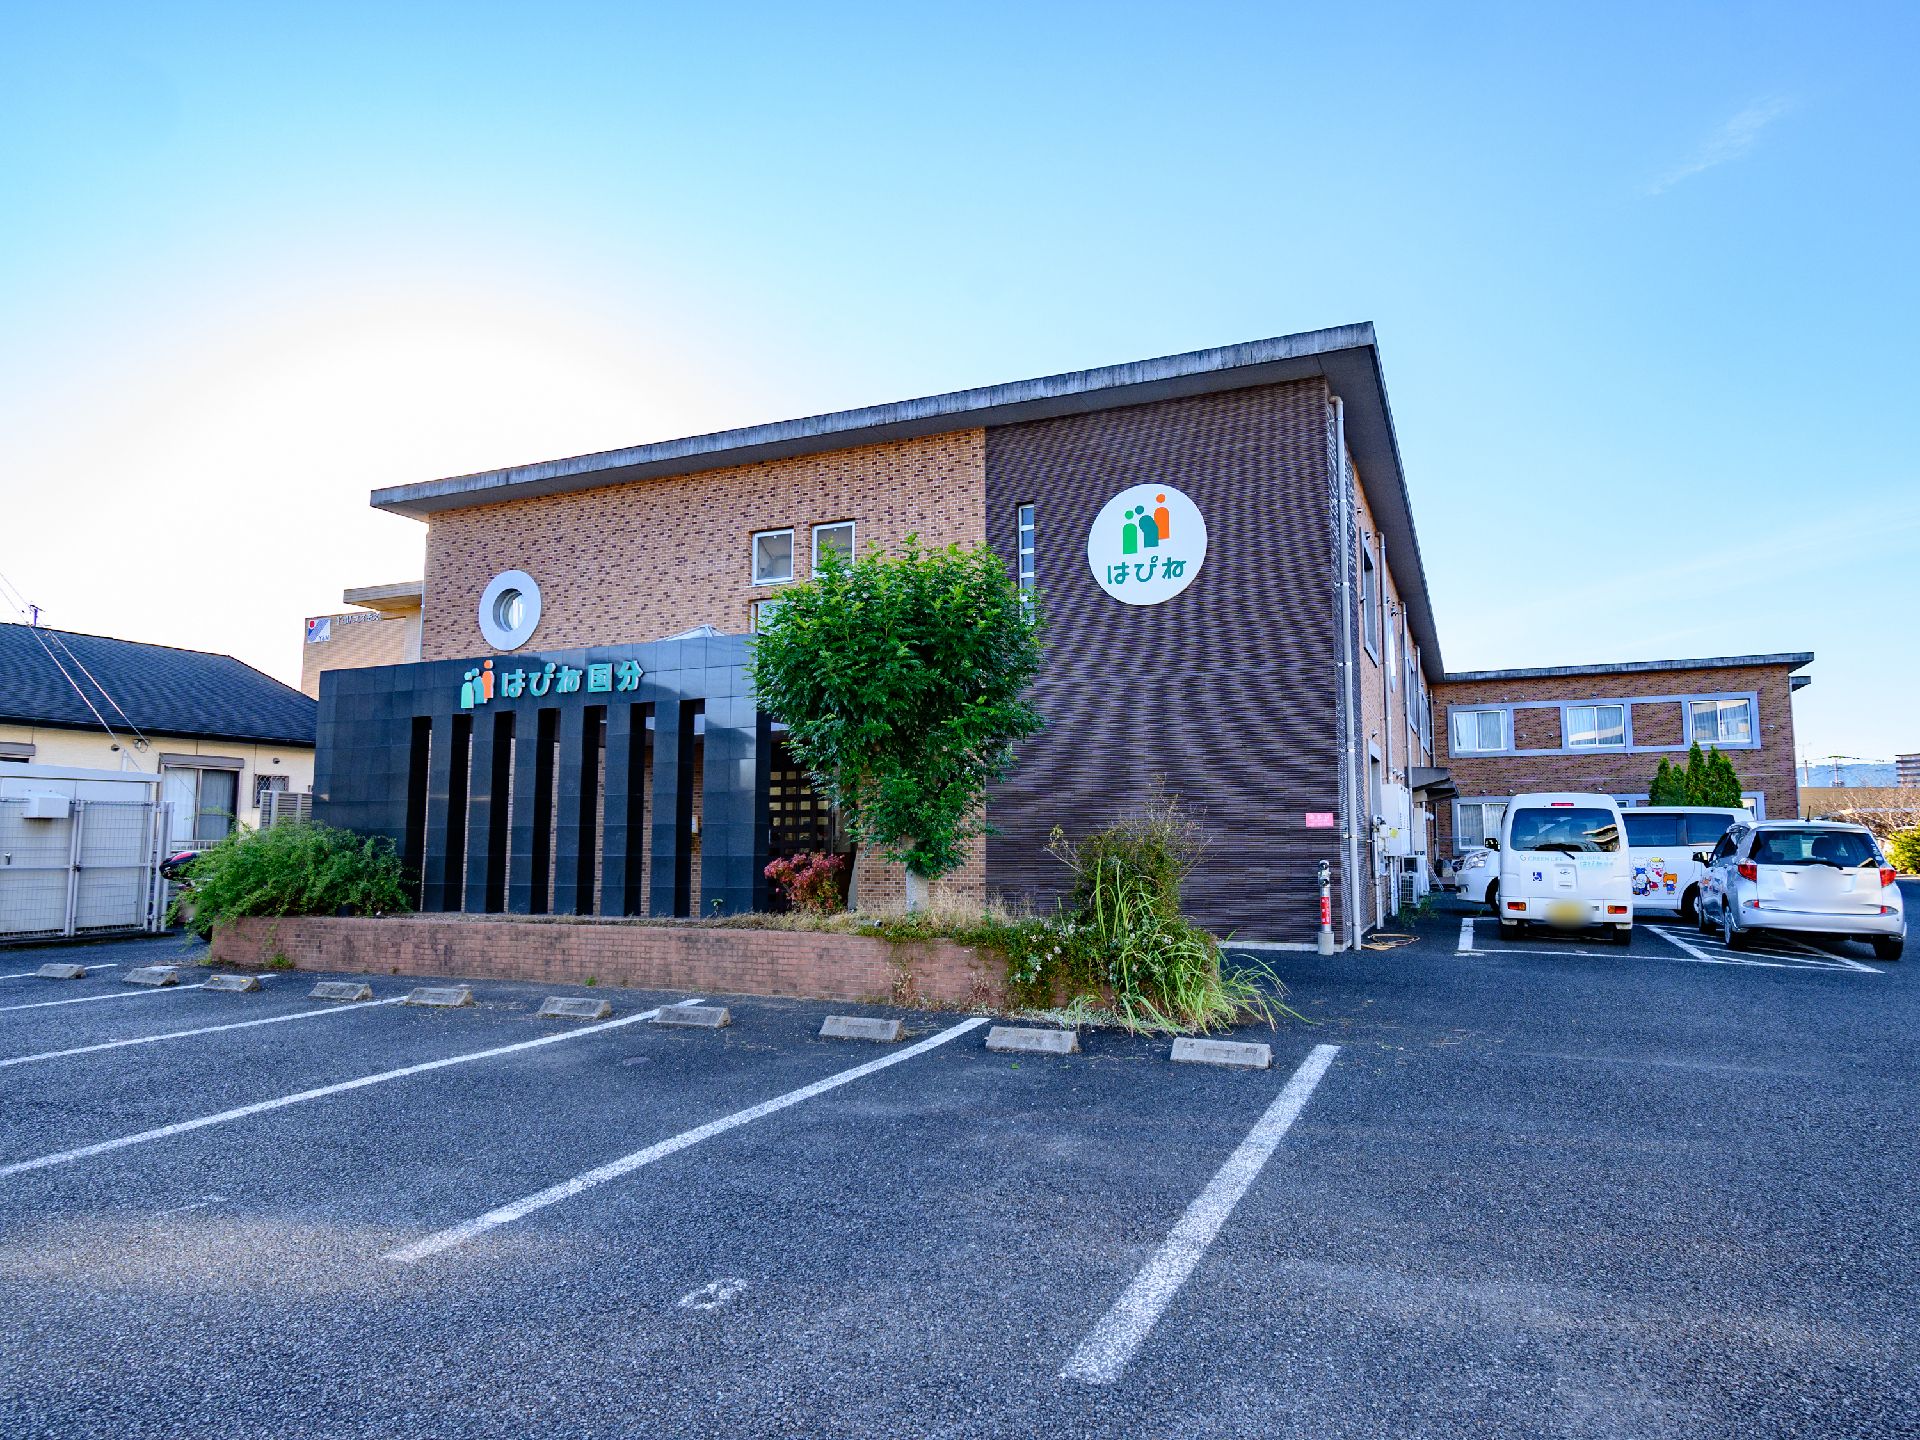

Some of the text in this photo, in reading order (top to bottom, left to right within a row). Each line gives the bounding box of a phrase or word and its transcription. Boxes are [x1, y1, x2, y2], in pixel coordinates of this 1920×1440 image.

[1107, 555, 1187, 585] はぴね
[501, 659, 644, 698] はぴね国分
